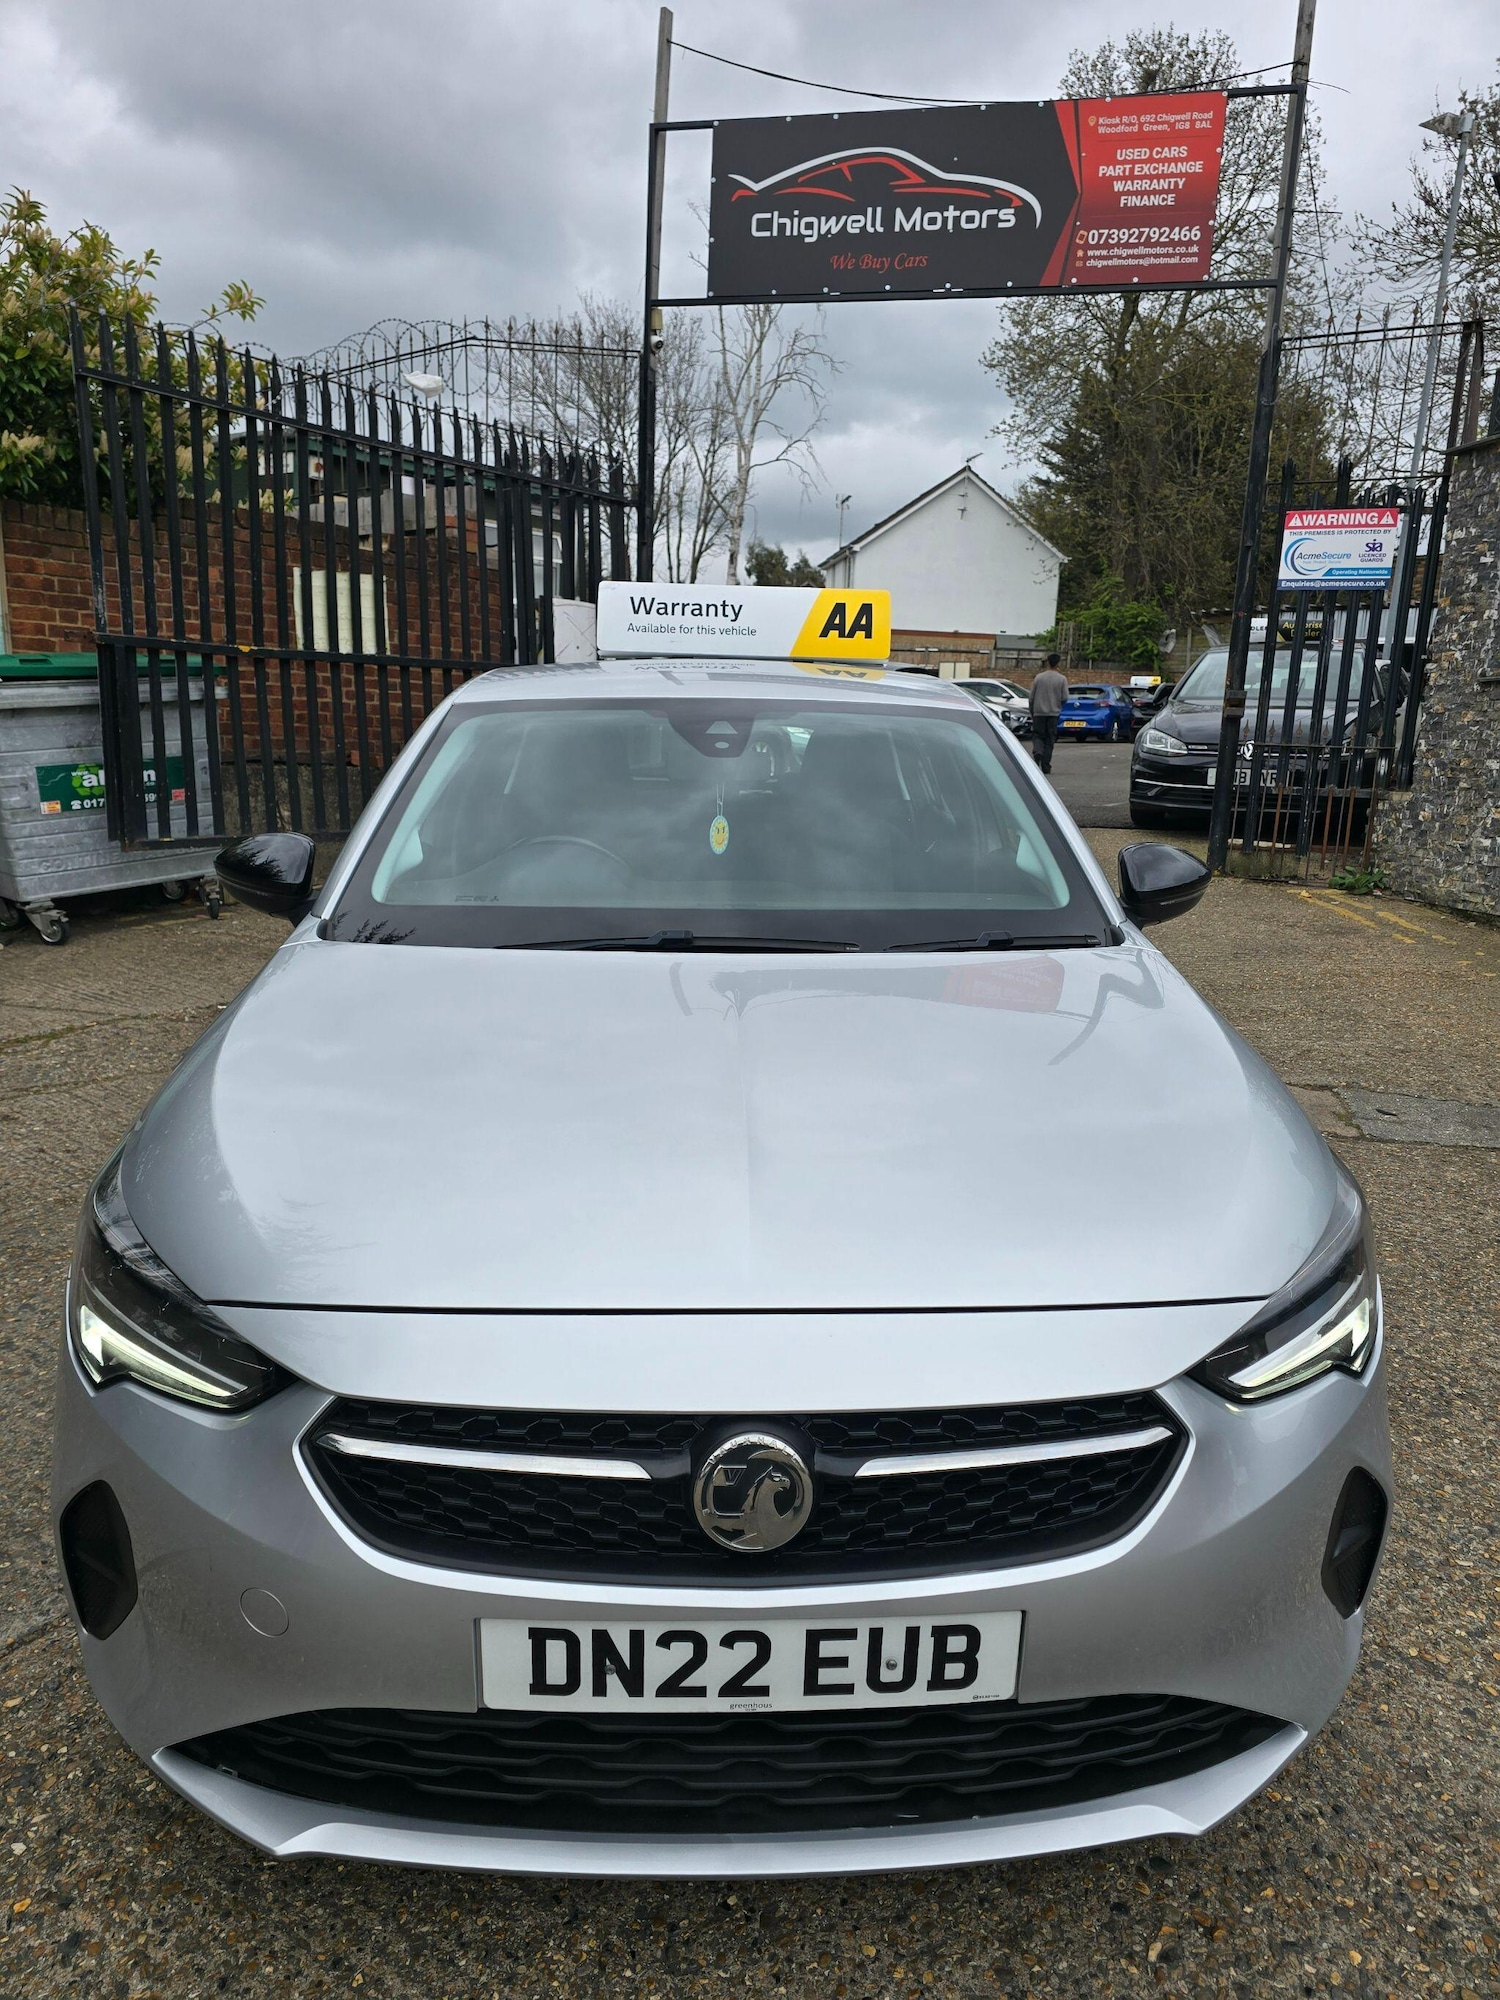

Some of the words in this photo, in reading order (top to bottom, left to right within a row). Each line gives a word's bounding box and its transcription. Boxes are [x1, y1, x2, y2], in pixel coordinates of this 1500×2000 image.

[1098, 116, 1121, 125] Kiosk
[1140, 114, 1155, 123] 692
[1157, 112, 1190, 123] Chigwell
[1192, 111, 1213, 120] Road
[1098, 124, 1138, 134] Woodford
[1143, 123, 1170, 132] Green,
[1175, 121, 1190, 130] IG8
[1195, 120, 1212, 129] 8AL
[1116, 147, 1150, 160] USED
[1152, 146, 1188, 159] CARS
[1098, 164, 1133, 177] PART
[1134, 161, 1204, 176] EXCHANGE
[1113, 177, 1186, 192] WARRANTY
[1120, 194, 1175, 208] FINANCE
[750, 206, 884, 243] Chigwell
[894, 204, 1017, 233] Motors
[1087, 225, 1201, 245] 07392792466
[1087, 244, 1199, 257] www.chigwellmotors.co.uk
[830, 253, 856, 271] We
[859, 252, 892, 274] Buy
[894, 252, 928, 269] Cars
[1086, 256, 1198, 269] chigwellmotors@hotmail.com
[1302, 512, 1379, 526] WARNING
[1296, 551, 1352, 561] AcmeSecure
[1281, 580, 1386, 588] Enquiries@acmesecure.co.uk
[630, 596, 743, 622] Warranty
[818, 602, 873, 639] AA
[627, 622, 676, 635] Available
[679, 623, 695, 635] for
[697, 623, 716, 635] this
[718, 625, 757, 637] vehicle
[528, 1626, 772, 1699] DN22
[802, 1623, 983, 1696] EUB
[729, 1702, 773, 1710] greenhous
